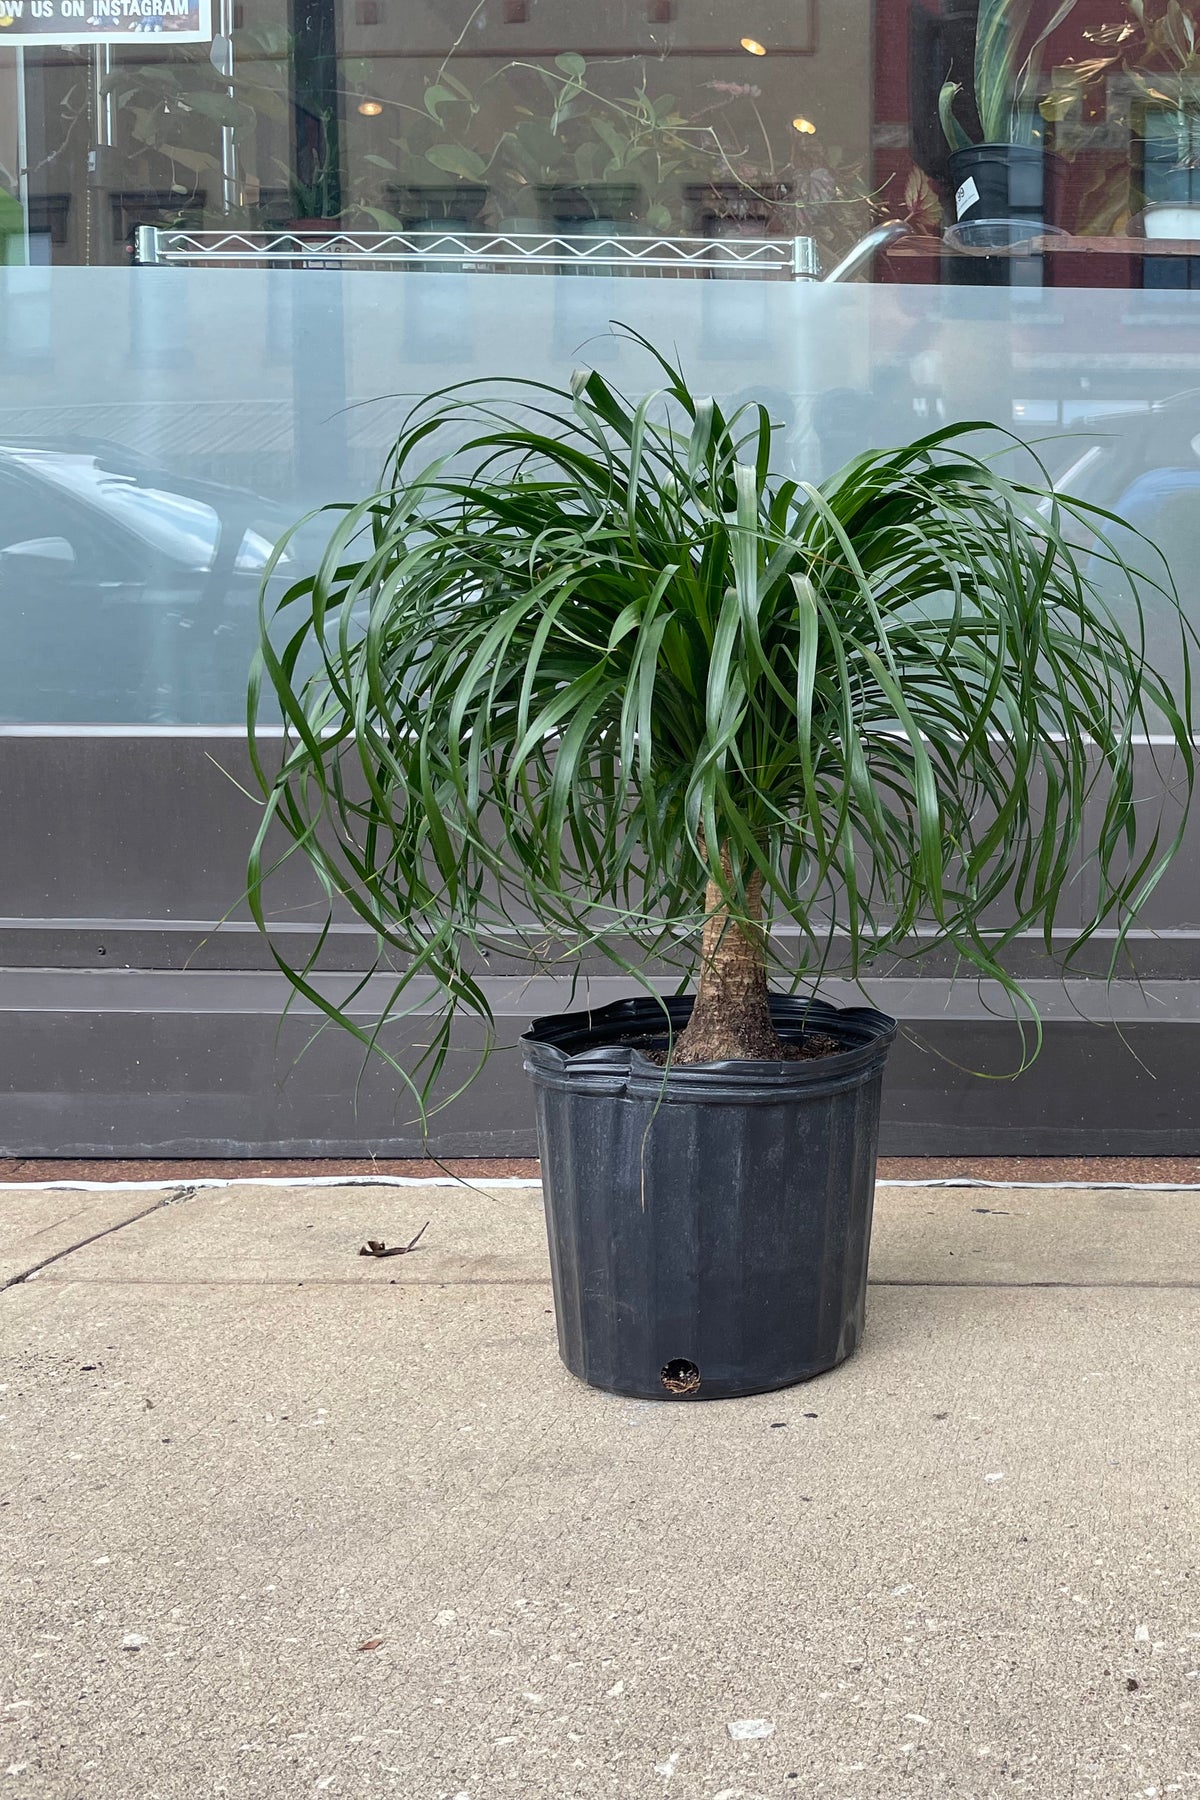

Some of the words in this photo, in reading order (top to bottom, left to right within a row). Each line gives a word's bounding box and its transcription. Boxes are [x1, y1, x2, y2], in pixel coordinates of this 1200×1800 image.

[31, 0, 53, 17] US
[61, 0, 85, 17] ON
[93, 0, 189, 16] INSTAGRAM
